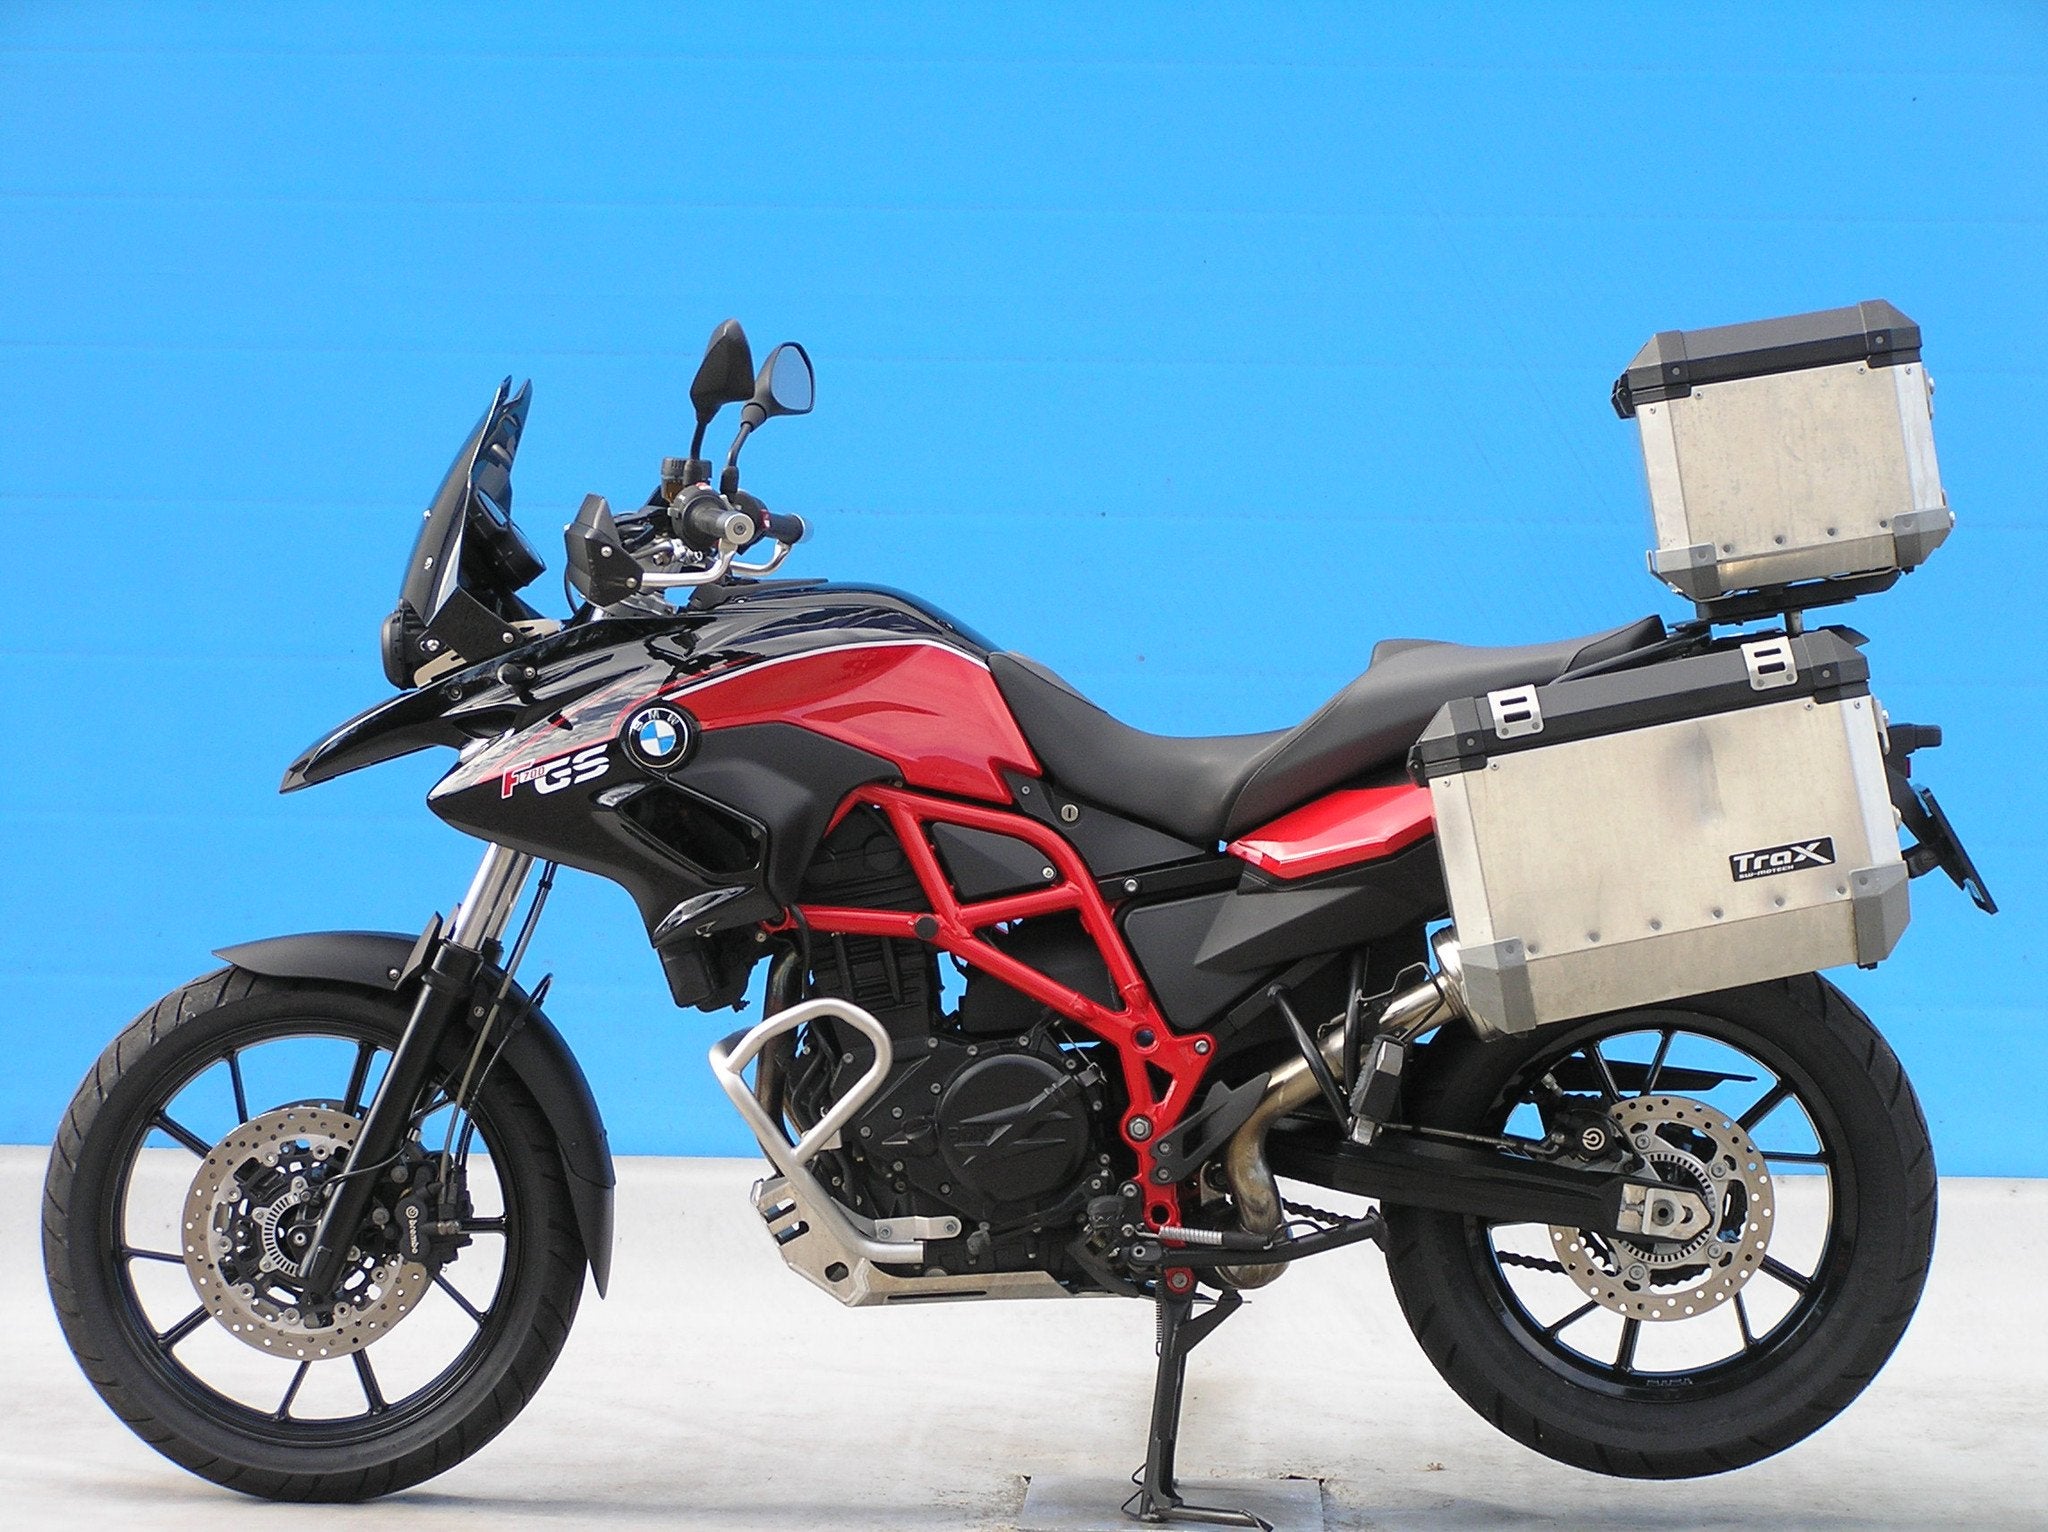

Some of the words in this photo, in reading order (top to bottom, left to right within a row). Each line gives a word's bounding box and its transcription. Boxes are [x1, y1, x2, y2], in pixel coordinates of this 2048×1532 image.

[633, 709, 680, 731] BMW
[1733, 842, 1832, 872] TraX
[408, 1219, 420, 1254] brembo
